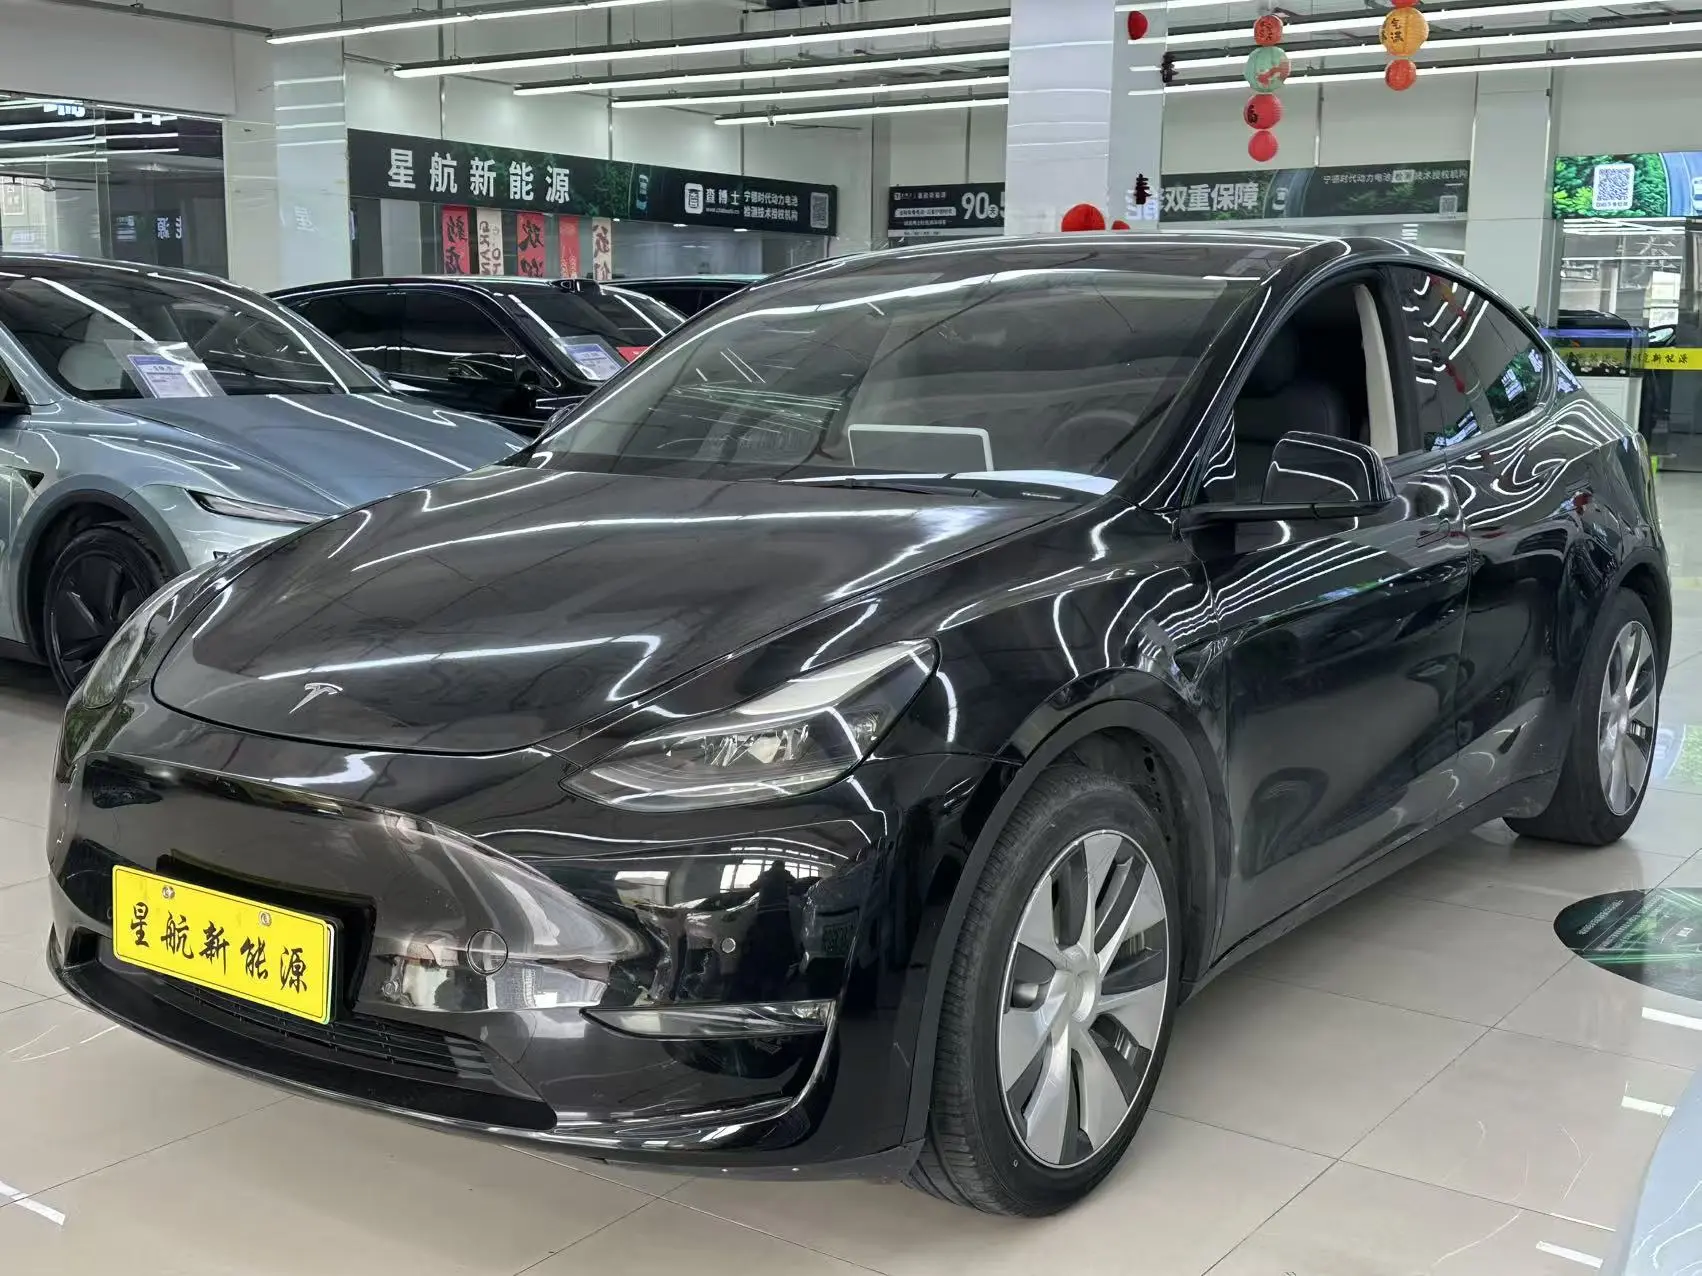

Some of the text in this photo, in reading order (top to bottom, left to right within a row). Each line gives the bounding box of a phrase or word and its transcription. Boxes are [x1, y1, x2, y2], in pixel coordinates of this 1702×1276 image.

[387, 148, 570, 204] 星航新能源
[1160, 182, 1259, 213] 双重保障
[130, 901, 308, 994] 星航新能源
